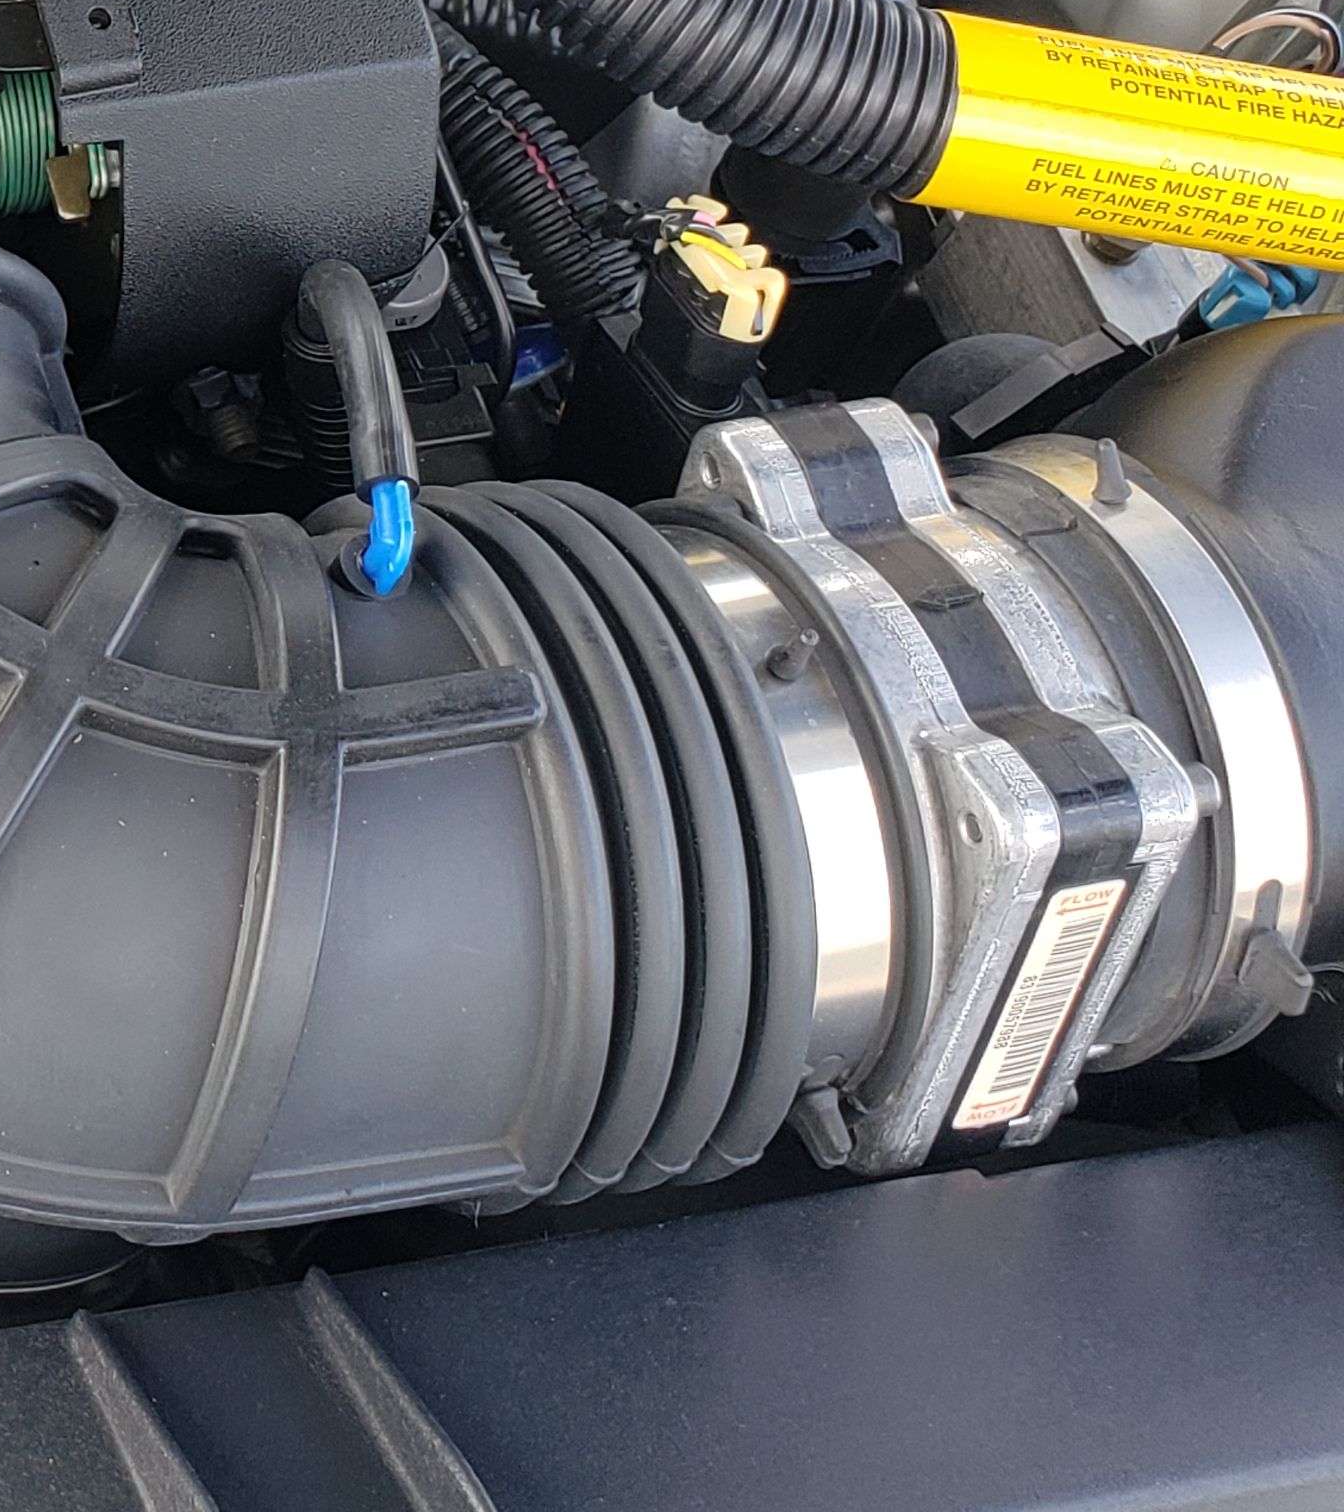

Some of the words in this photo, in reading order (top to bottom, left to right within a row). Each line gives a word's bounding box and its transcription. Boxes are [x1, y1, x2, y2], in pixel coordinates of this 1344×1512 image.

[1045, 49, 1072, 65] BY
[1081, 55, 1190, 84] RETAINER
[1195, 75, 1266, 97] STRAP
[1272, 88, 1302, 103] TO
[1110, 78, 1231, 110] POTENTIAL
[1237, 100, 1286, 120] FIRE
[1032, 158, 1086, 180] FUEL
[1093, 168, 1158, 191] LINES
[1162, 180, 1227, 203] MUST
[1231, 192, 1262, 209] BE
[1267, 197, 1326, 219] HELD
[1191, 161, 1289, 191] CAUTION
[1025, 179, 1058, 194] BY
[1060, 185, 1171, 215] RETAINER
[1175, 204, 1249, 226] STRAP
[1255, 218, 1284, 233] TO
[1289, 224, 1344, 244] HELP
[1074, 207, 1195, 236] POTENTIAL
[1201, 228, 1254, 245] FIRE
[1060, 889, 1115, 906] FLOW
[966, 1103, 1018, 1122] FLOW
